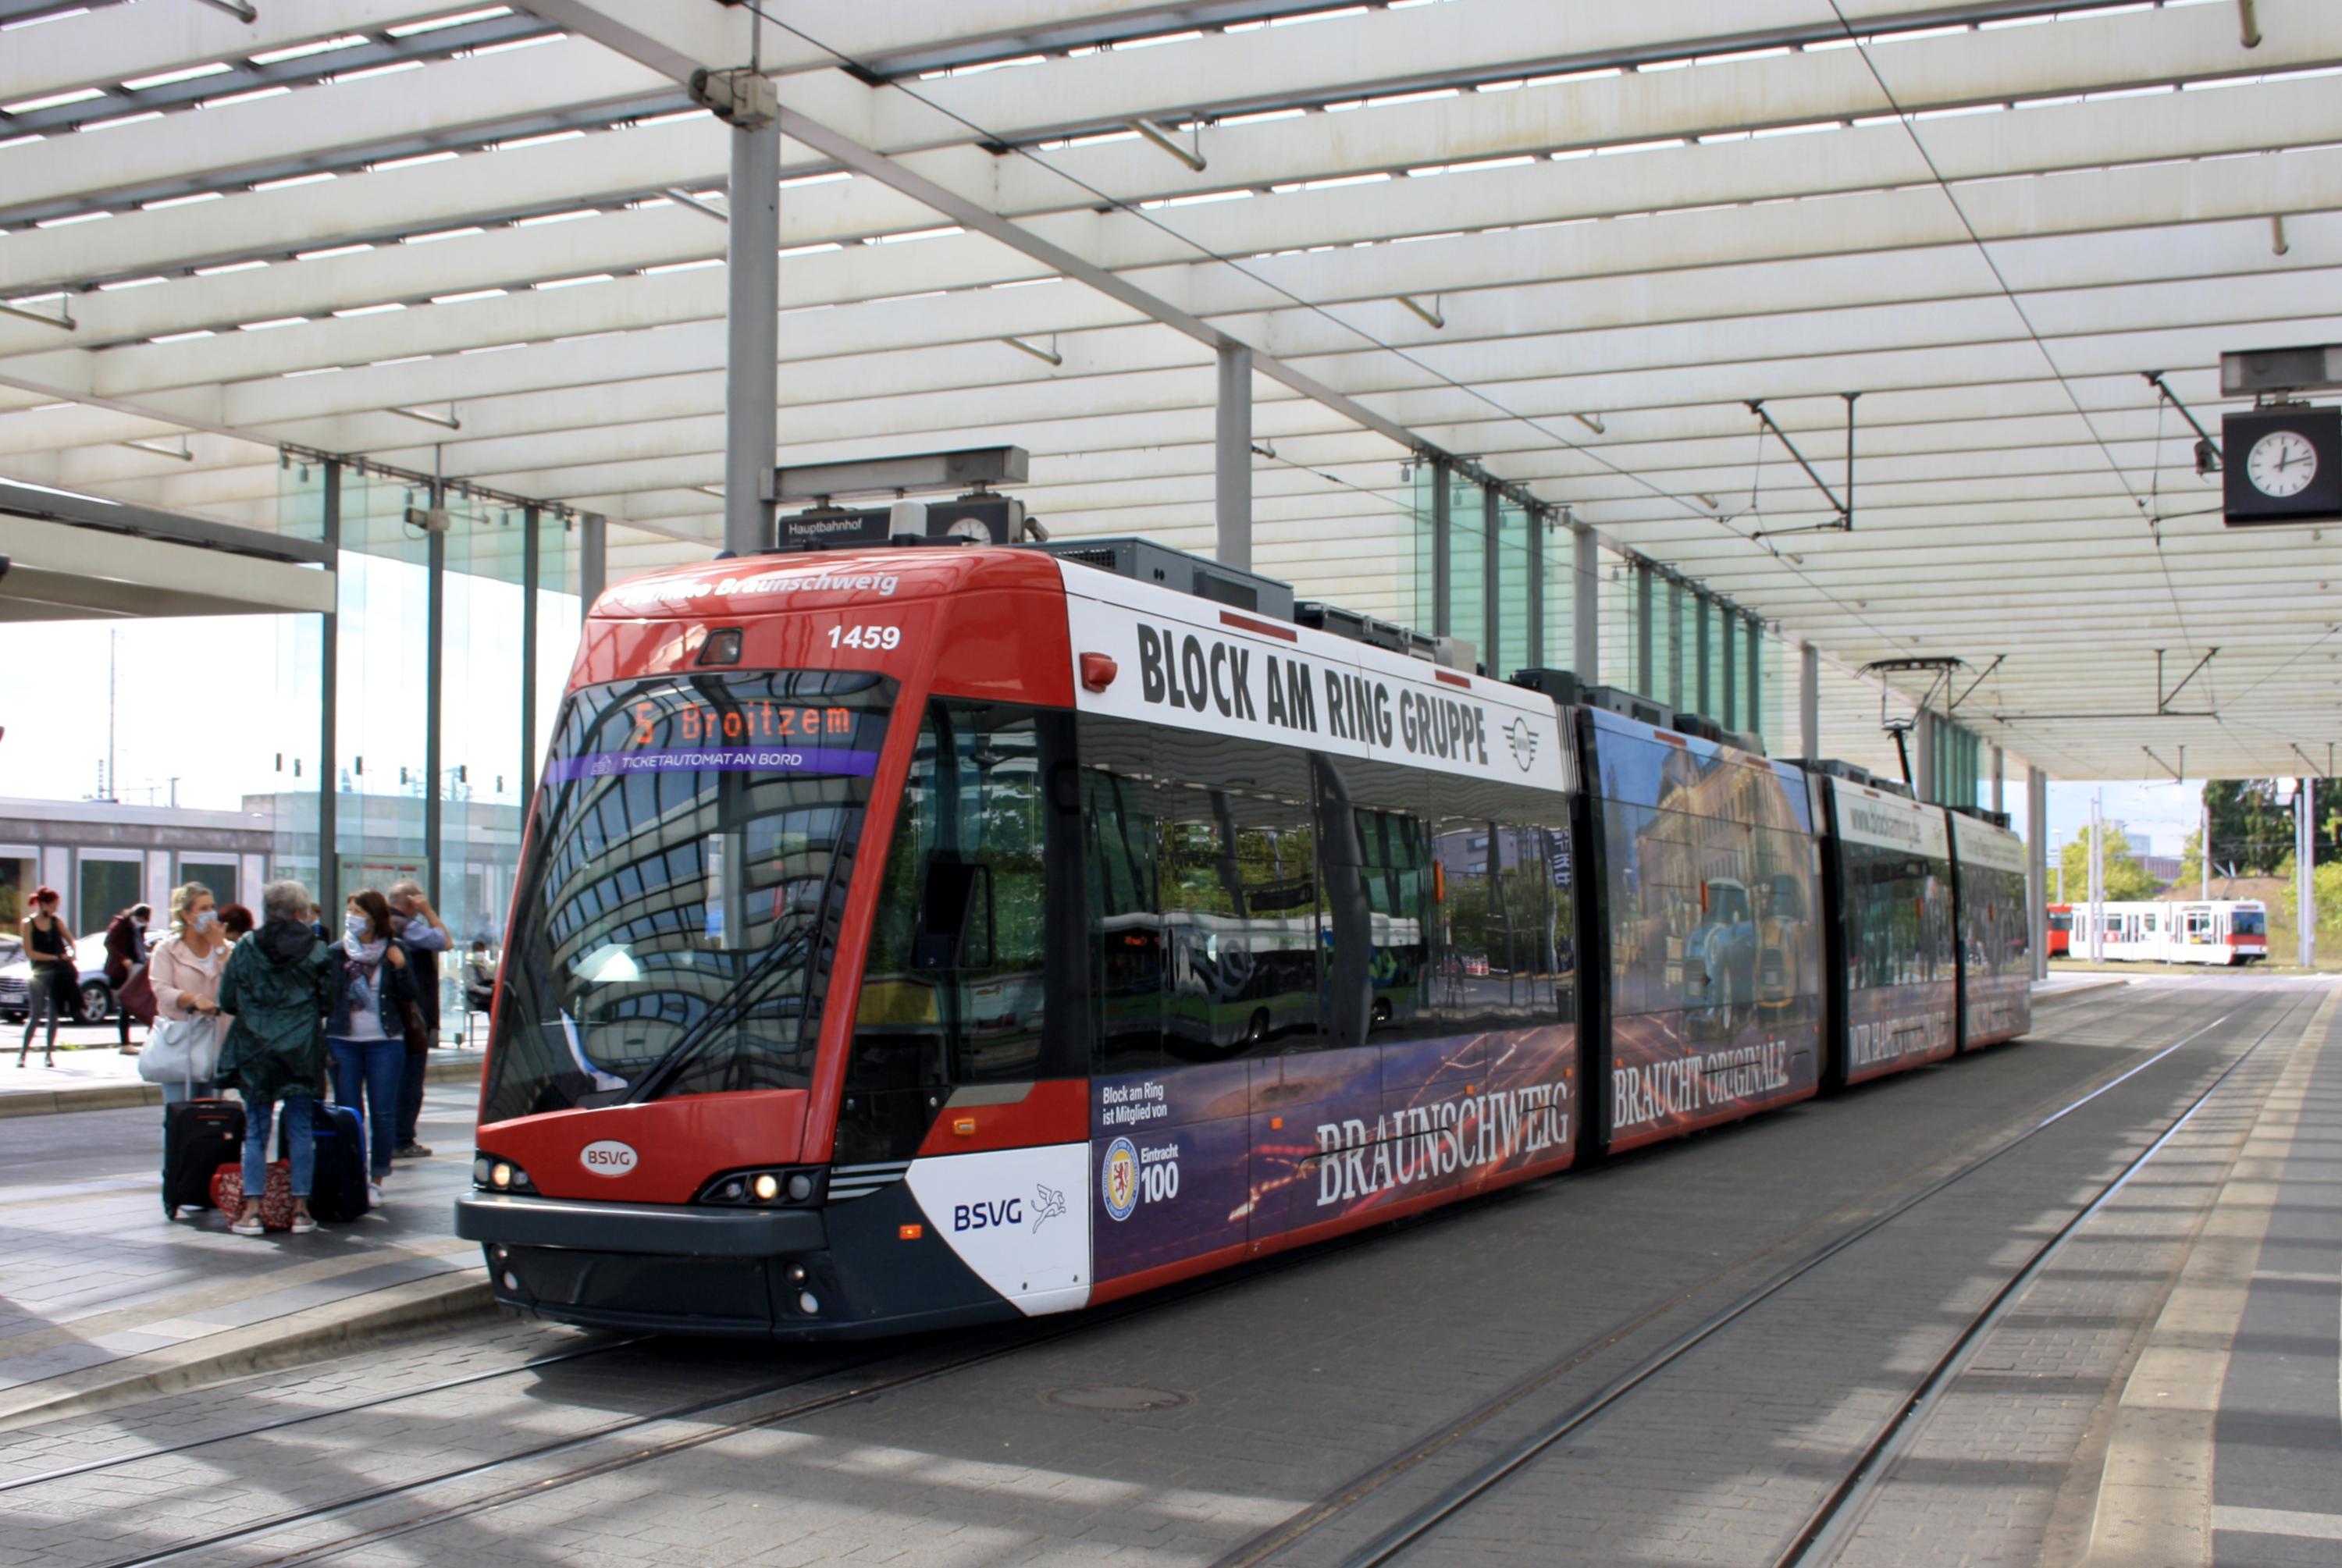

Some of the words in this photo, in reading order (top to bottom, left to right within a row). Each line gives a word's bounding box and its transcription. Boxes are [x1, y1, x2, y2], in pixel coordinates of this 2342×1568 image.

[788, 517, 863, 535] Hauptbahnhof
[714, 571, 899, 596] Braunschweig
[828, 624, 901, 649] 1459
[1137, 623, 1257, 722] BLOCK
[1267, 654, 1318, 733] AM
[1325, 669, 1393, 748] RING
[1400, 688, 1489, 766] GRUPPE
[635, 702, 655, 744] 5
[682, 699, 851, 739] Broitzem
[621, 752, 731, 768] TICKETAUTOMAT
[732, 752, 757, 766] AN
[758, 752, 803, 766] BORD
[1102, 1084, 1128, 1104] Block
[1129, 1087, 1143, 1101] am
[1144, 1081, 1163, 1101] Ring
[1613, 1055, 1703, 1129] BRAUCHT
[1706, 1040, 1790, 1105] ORIGINALE
[1102, 1108, 1115, 1125] ist
[1116, 1101, 1151, 1125] Mitglied
[1151, 1104, 1167, 1118] von
[1141, 1143, 1179, 1164] Eintracht
[1316, 1081, 1568, 1207] BRAUNSCHWEIG
[588, 1150, 630, 1165] BSVG
[1141, 1161, 1179, 1204] 100
[954, 1198, 1022, 1232] BSVG
